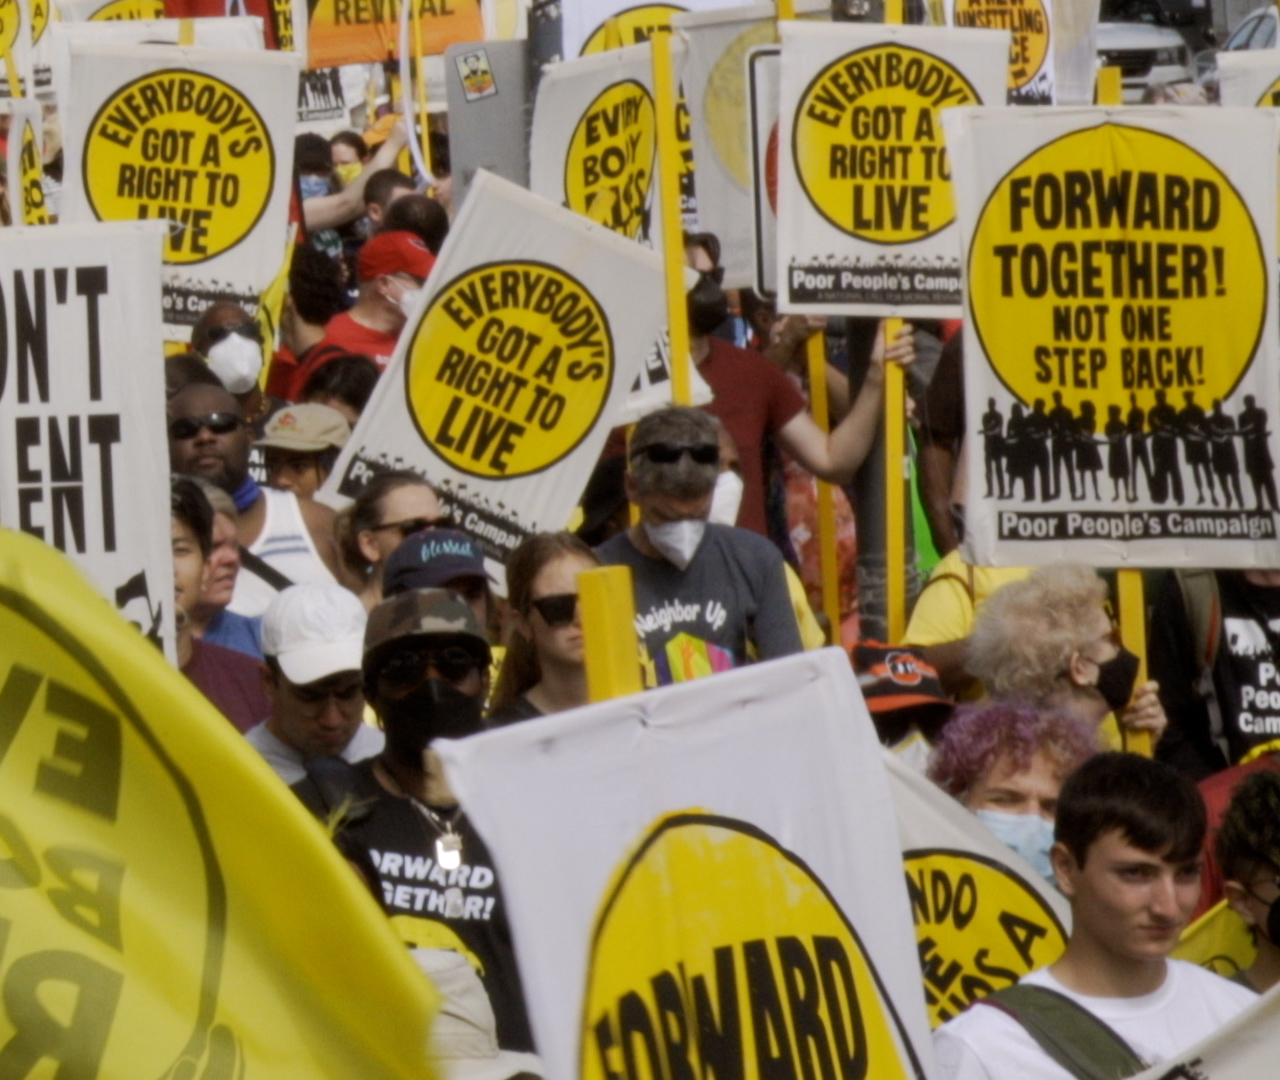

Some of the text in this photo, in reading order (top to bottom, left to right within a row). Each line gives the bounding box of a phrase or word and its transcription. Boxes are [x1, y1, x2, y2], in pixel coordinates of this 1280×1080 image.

[99, 78, 262, 159] EVERYBODY'S
[850, 106, 935, 143] GOT A
[141, 128, 221, 168] GOT A
[830, 145, 913, 181] RIGHT
[117, 164, 239, 208] RIGHT TO
[852, 185, 932, 232] LIVE
[1009, 169, 1221, 233] FORWARD
[792, 270, 910, 291] Poor People's
[992, 240, 1226, 300] TOGETHER!
[443, 269, 604, 383] EVERYBODY'S
[1052, 305, 1173, 342] NOT ONE
[477, 317, 564, 384] GOT A
[1034, 345, 1205, 390] STEP BACK!
[435, 345, 566, 432] RIGHT TO
[435, 397, 527, 474] LIVE
[1001, 512, 1273, 540] Poor People's Campaign
[634, 598, 727, 638] Neighbor Up
[998, 910, 1048, 970] A
